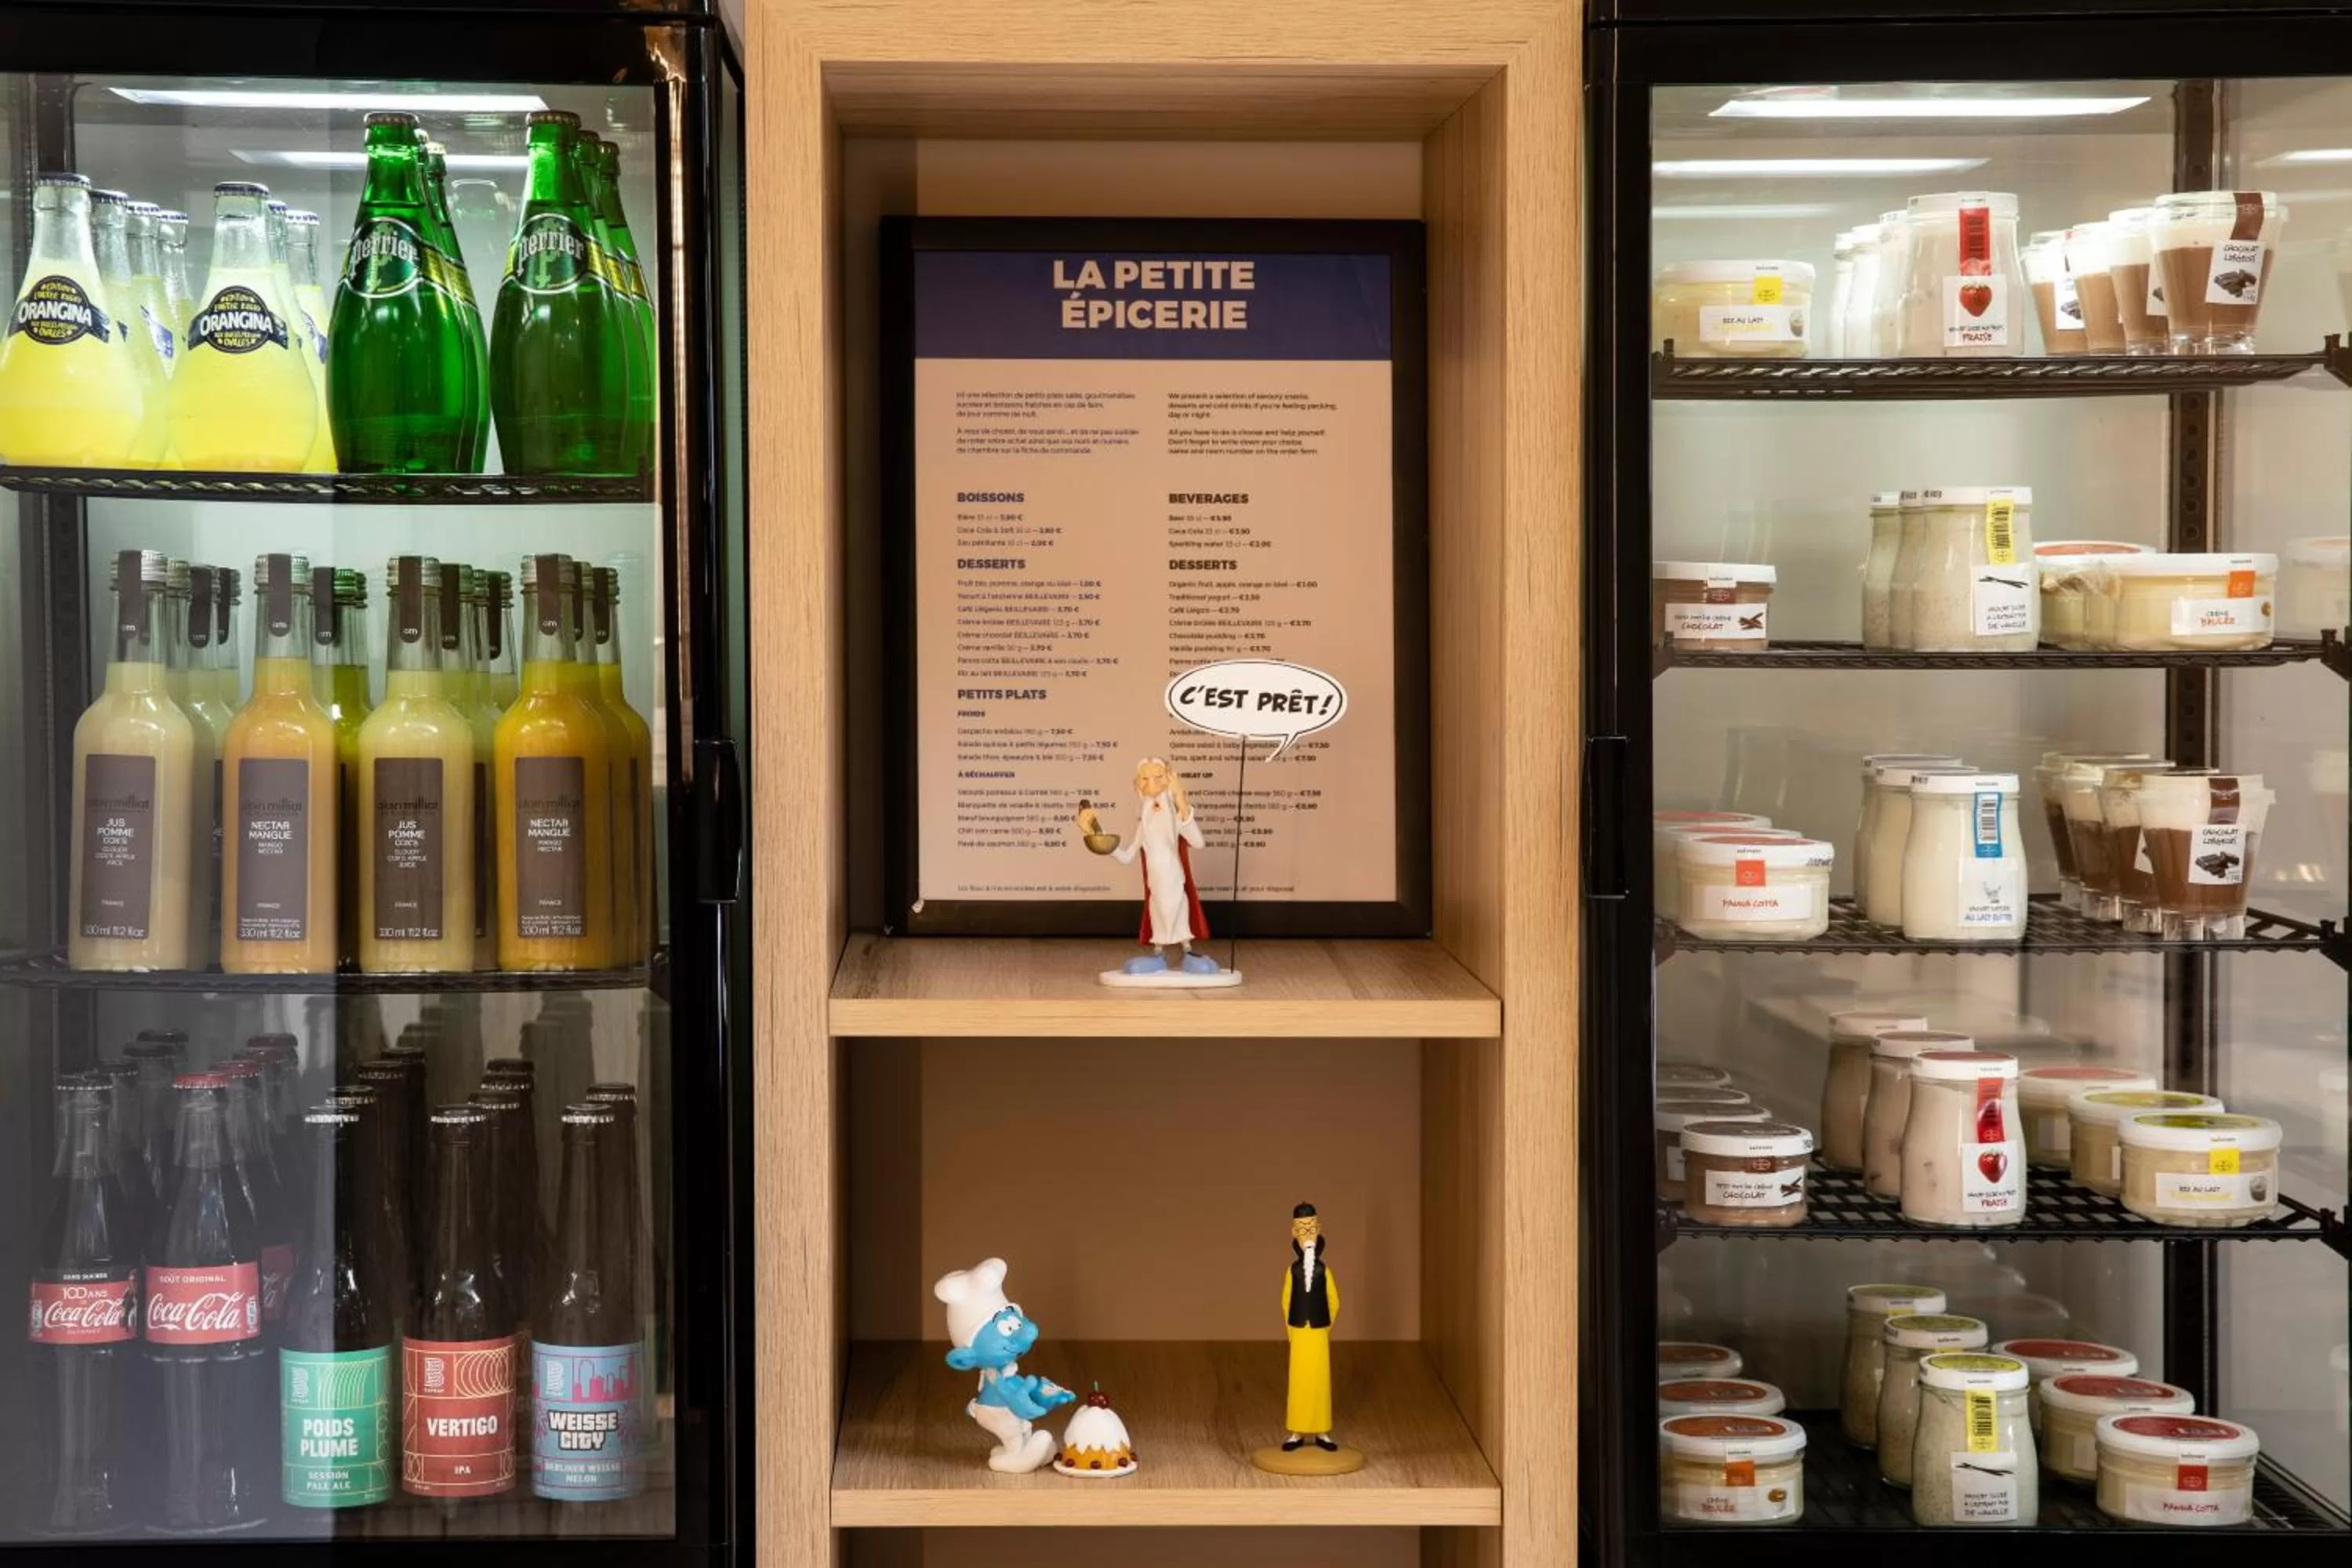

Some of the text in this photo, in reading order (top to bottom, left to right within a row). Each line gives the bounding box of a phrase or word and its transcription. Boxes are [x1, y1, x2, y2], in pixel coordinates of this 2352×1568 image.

[1053, 260, 1255, 289] LA PETITE
[18, 301, 92, 326] ORANGINA
[1062, 291, 1247, 329] ÉPICERIE
[200, 311, 274, 336] ORANGINA
[957, 492, 1025, 502] BOISSONS
[1169, 493, 1249, 503] BEVERAGES
[957, 559, 1025, 569] DESSERTS
[1169, 560, 1237, 570] DESSERTS
[957, 689, 1047, 699] PETITS PLATS
[1180, 686, 1248, 708] C'EST
[107, 818, 125, 827] JUS
[251, 821, 290, 830] NECTAR
[398, 820, 417, 829] JUS
[530, 818, 568, 827] NECTAR
[97, 827, 134, 837] POMME
[249, 830, 292, 840] MANGUE
[388, 829, 426, 839] POMME
[528, 828, 571, 837] MANGUE
[241, 927, 256, 938] 330
[256, 927, 267, 938] ml
[379, 927, 394, 937] 330
[63, 1287, 86, 1300] 100
[44, 1299, 125, 1328] Coca-Cola
[147, 1292, 245, 1330] Coca-Cola
[426, 1415, 498, 1437] VERTIGO
[549, 1412, 618, 1431] WEISSE
[303, 1417, 354, 1437] POIDS
[560, 1432, 604, 1450] CITY
[300, 1439, 358, 1457] PLUME
[308, 1471, 349, 1479] SESSION
[454, 1465, 470, 1475] IPA
[307, 1481, 351, 1490] PALE ALE
